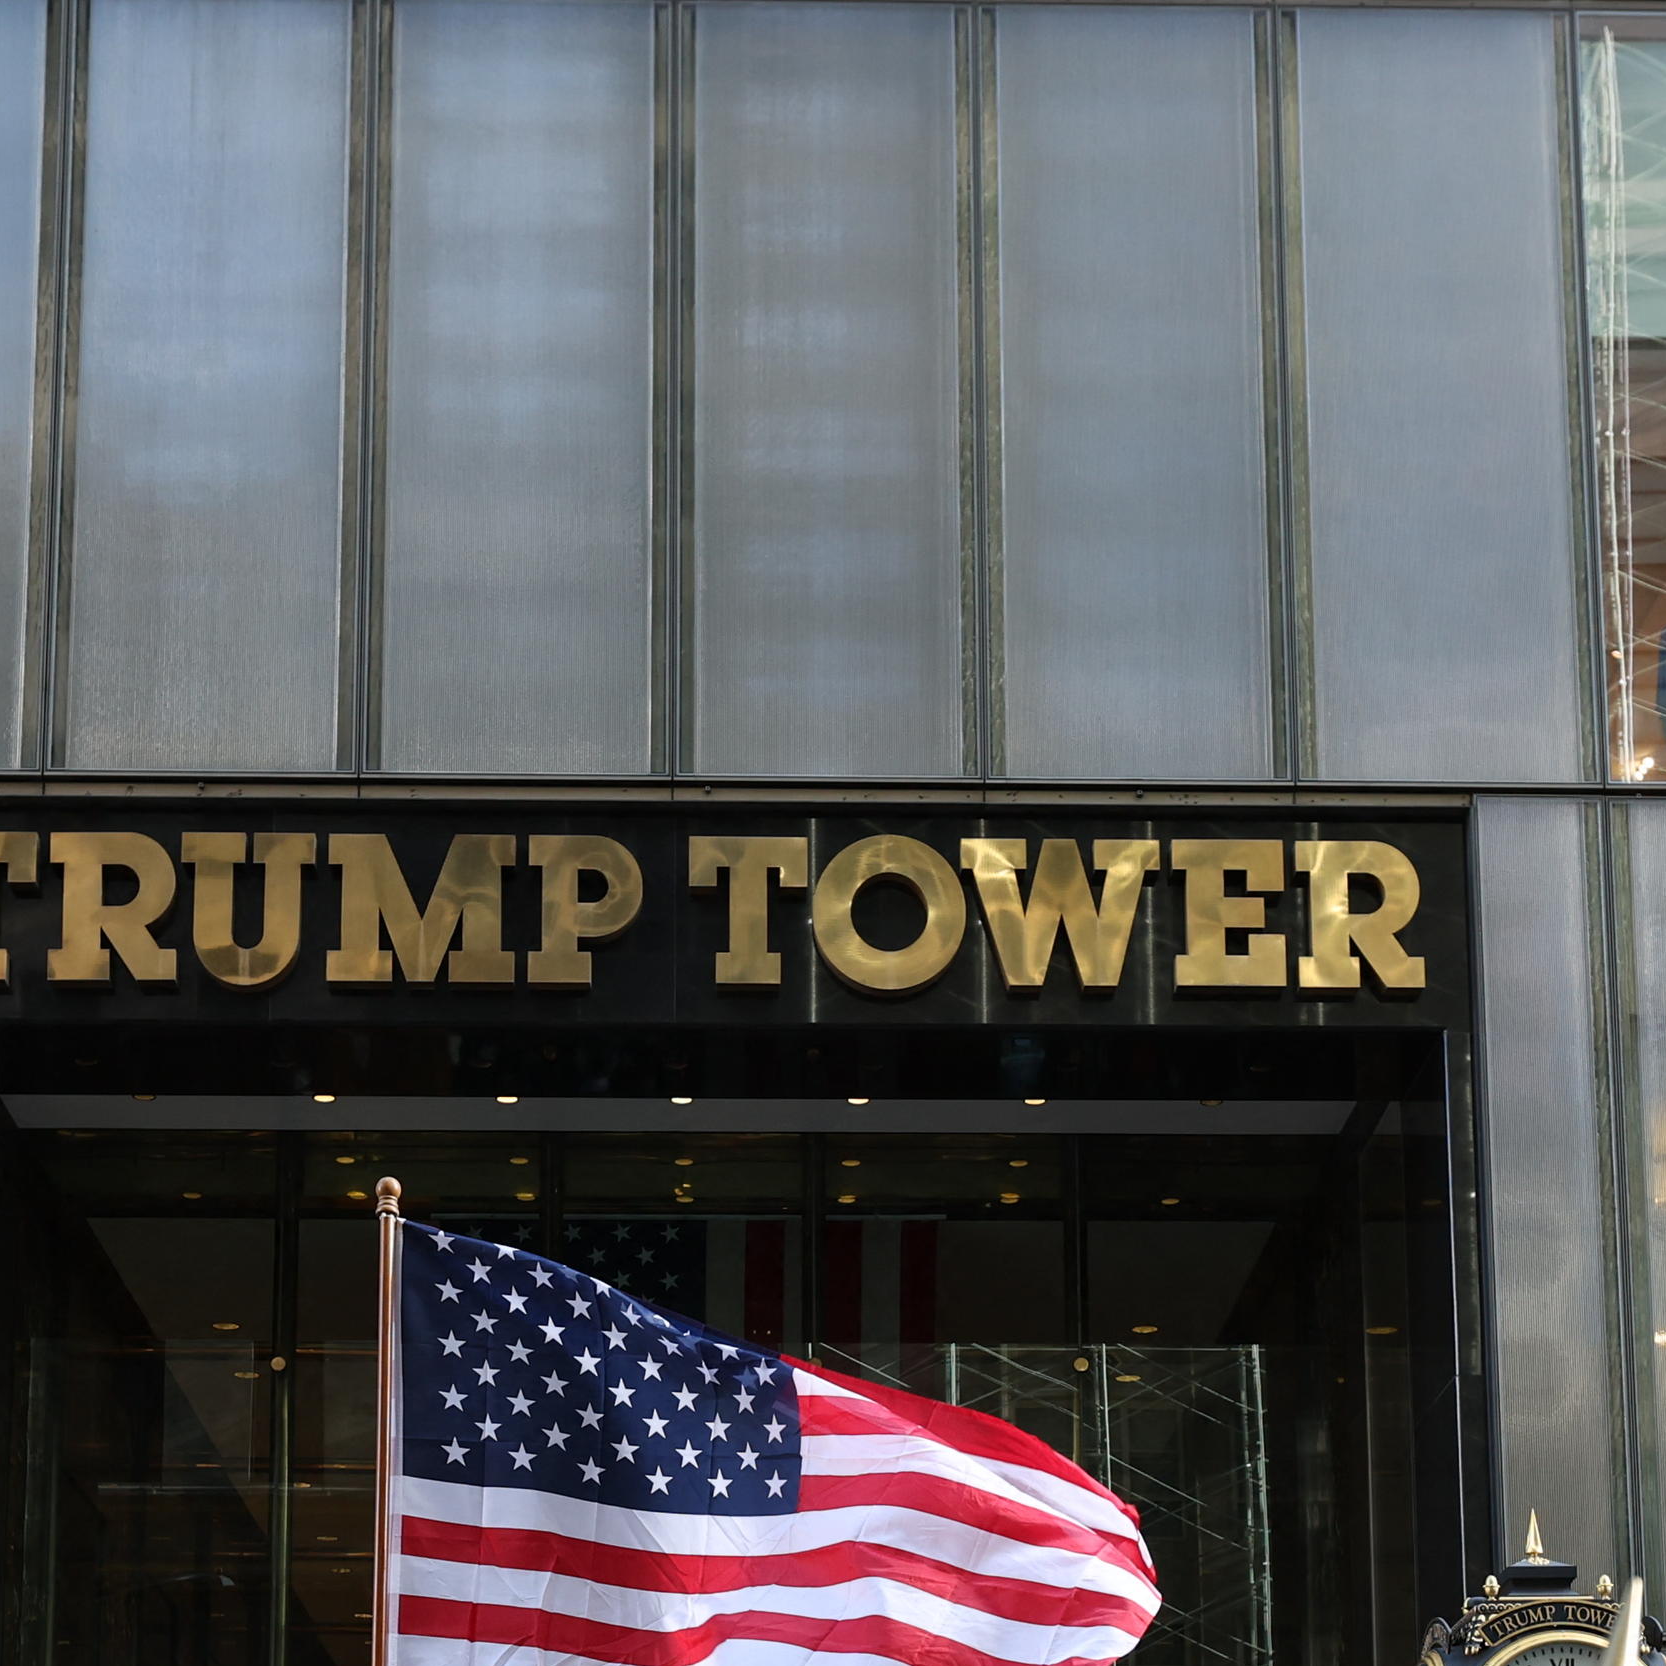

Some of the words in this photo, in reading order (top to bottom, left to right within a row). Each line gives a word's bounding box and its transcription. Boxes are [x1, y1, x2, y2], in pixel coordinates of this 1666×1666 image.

[688, 834, 1427, 995] TOWER
[1489, 1605, 1556, 1637] TRUMP
[1564, 1605, 1616, 1628] TOWE
